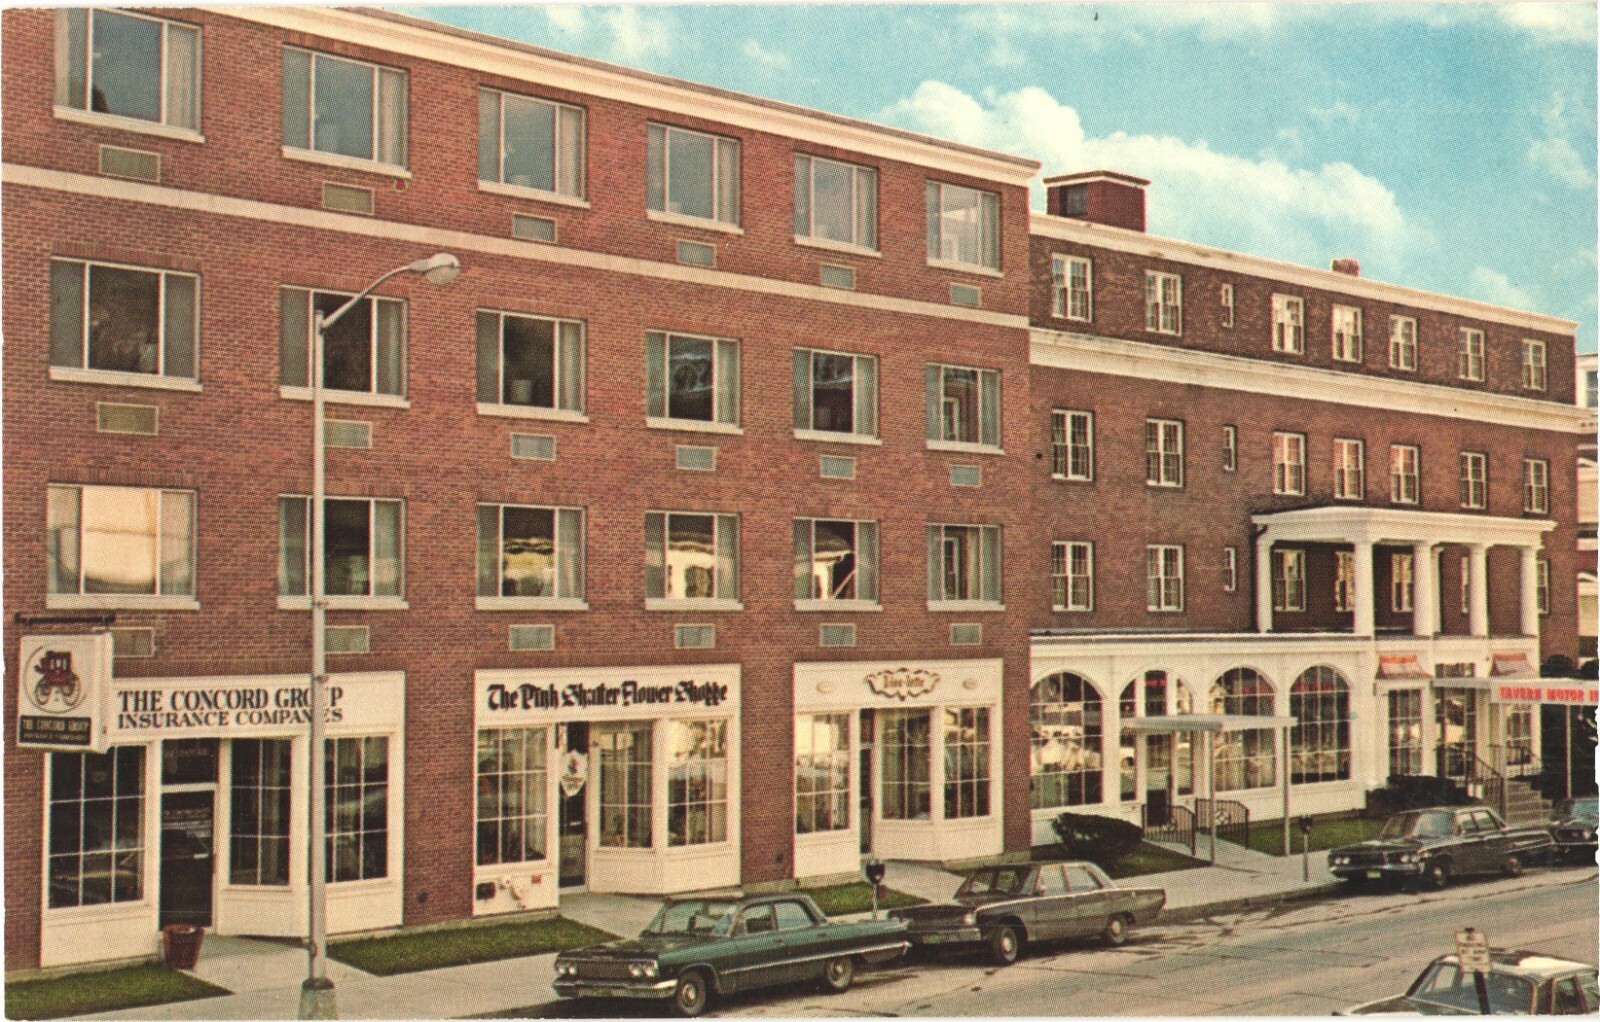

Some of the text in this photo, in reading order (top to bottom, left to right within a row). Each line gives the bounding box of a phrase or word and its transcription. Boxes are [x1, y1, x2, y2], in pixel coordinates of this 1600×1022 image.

[117, 686, 344, 712] THE CONCORD GROP
[487, 683, 519, 711] The
[519, 683, 559, 710] Pink
[620, 680, 673, 706] Flower
[674, 680, 728, 706] Shoppe
[1499, 687, 1542, 700] TAVERN
[1546, 689, 1584, 701] MOTOR
[118, 708, 344, 729] INSURANCE COMPANS
